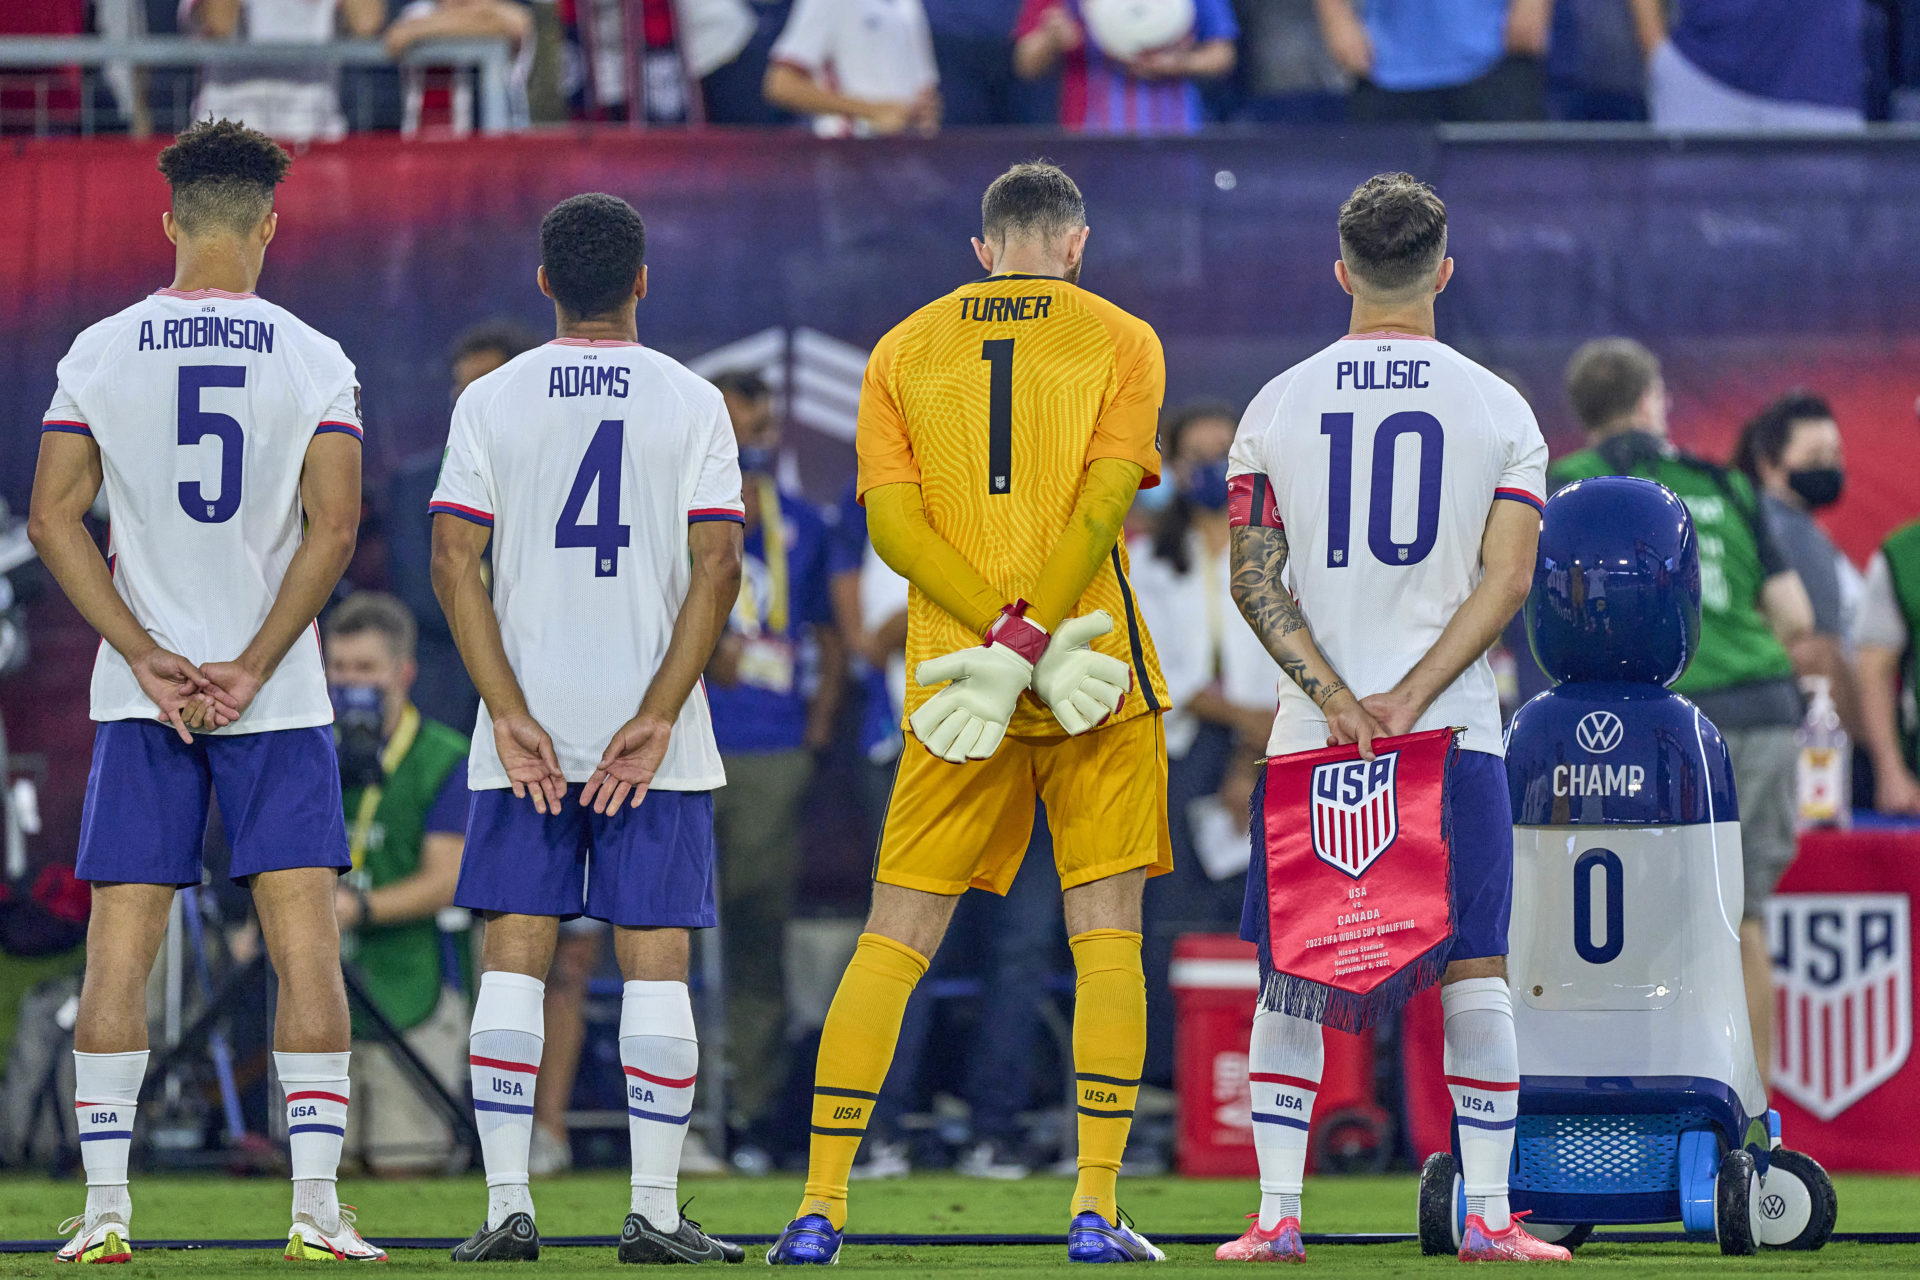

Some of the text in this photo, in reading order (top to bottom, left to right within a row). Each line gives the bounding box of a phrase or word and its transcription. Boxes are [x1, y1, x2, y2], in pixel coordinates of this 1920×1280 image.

[960, 296, 1052, 322] TURNER
[138, 316, 274, 353] A.ROBINSON
[549, 366, 631, 398] ADAMS
[1337, 360, 1430, 390] PULISIC
[981, 338, 1015, 495] 1
[177, 365, 246, 523] 5
[555, 420, 631, 577] 4
[1320, 410, 1444, 568] 10
[1317, 757, 1391, 806] USA
[1553, 764, 1645, 797] CHAMP
[1348, 886, 1367, 899] USA
[1352, 901, 1363, 909] vs.
[1573, 847, 1624, 965] 0
[1337, 908, 1380, 926] CANADA
[1305, 919, 1415, 949] 2022 FIFA WORLD CUP QUALIFYING
[1338, 942, 1384, 957] Nissan Stadium
[1335, 964, 1366, 976] September
[1375, 959, 1391, 968] 2021
[492, 1076, 523, 1096] USA
[629, 1084, 655, 1103] USA
[1084, 1088, 1118, 1104] USA
[291, 1105, 317, 1117] USA
[1275, 1093, 1303, 1111] USA
[1462, 1095, 1495, 1113] USA
[91, 1112, 118, 1124] USA
[833, 1106, 862, 1120] USA
